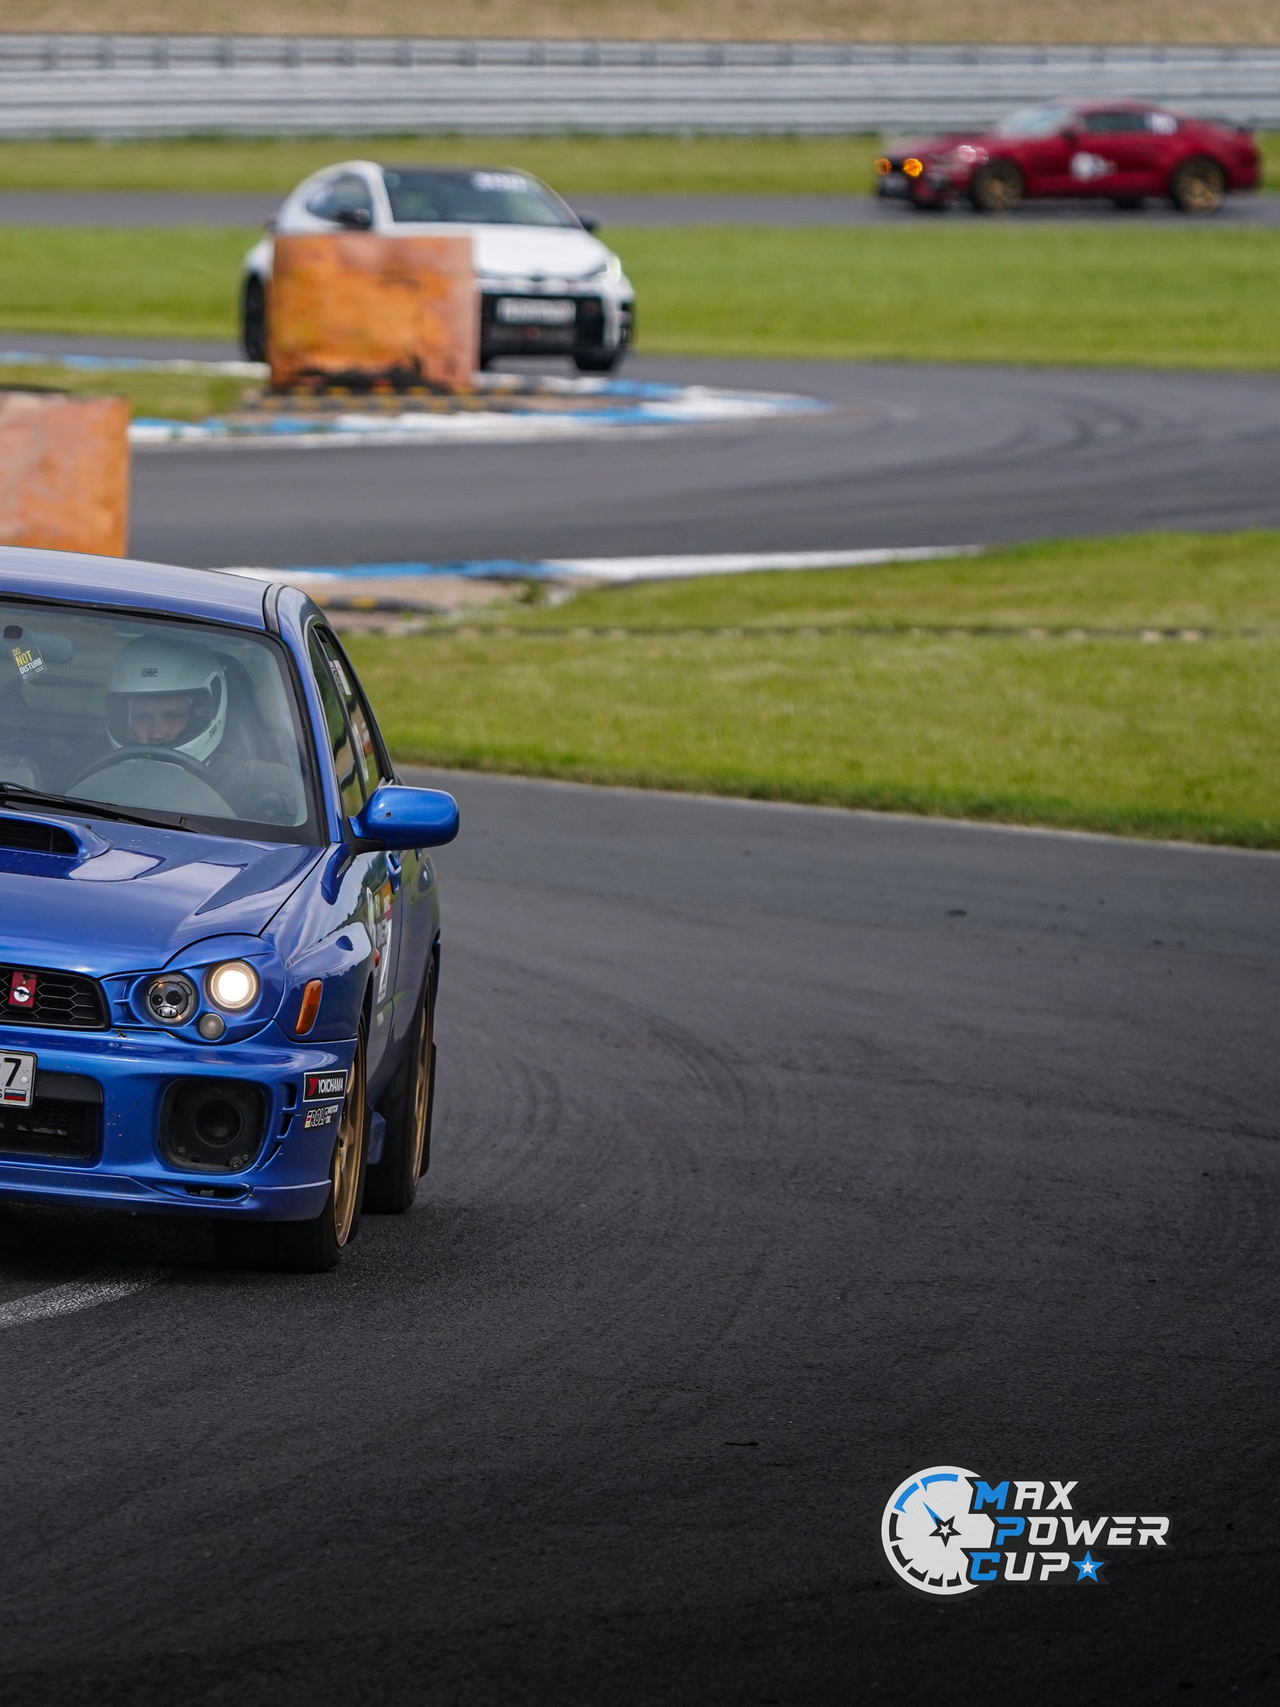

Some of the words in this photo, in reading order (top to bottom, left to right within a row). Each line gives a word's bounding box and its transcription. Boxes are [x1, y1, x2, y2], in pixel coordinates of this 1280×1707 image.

[15, 650, 32, 667] NOT
[19, 657, 42, 675] DISTURB
[318, 1077, 344, 1093] YOKOHAMA
